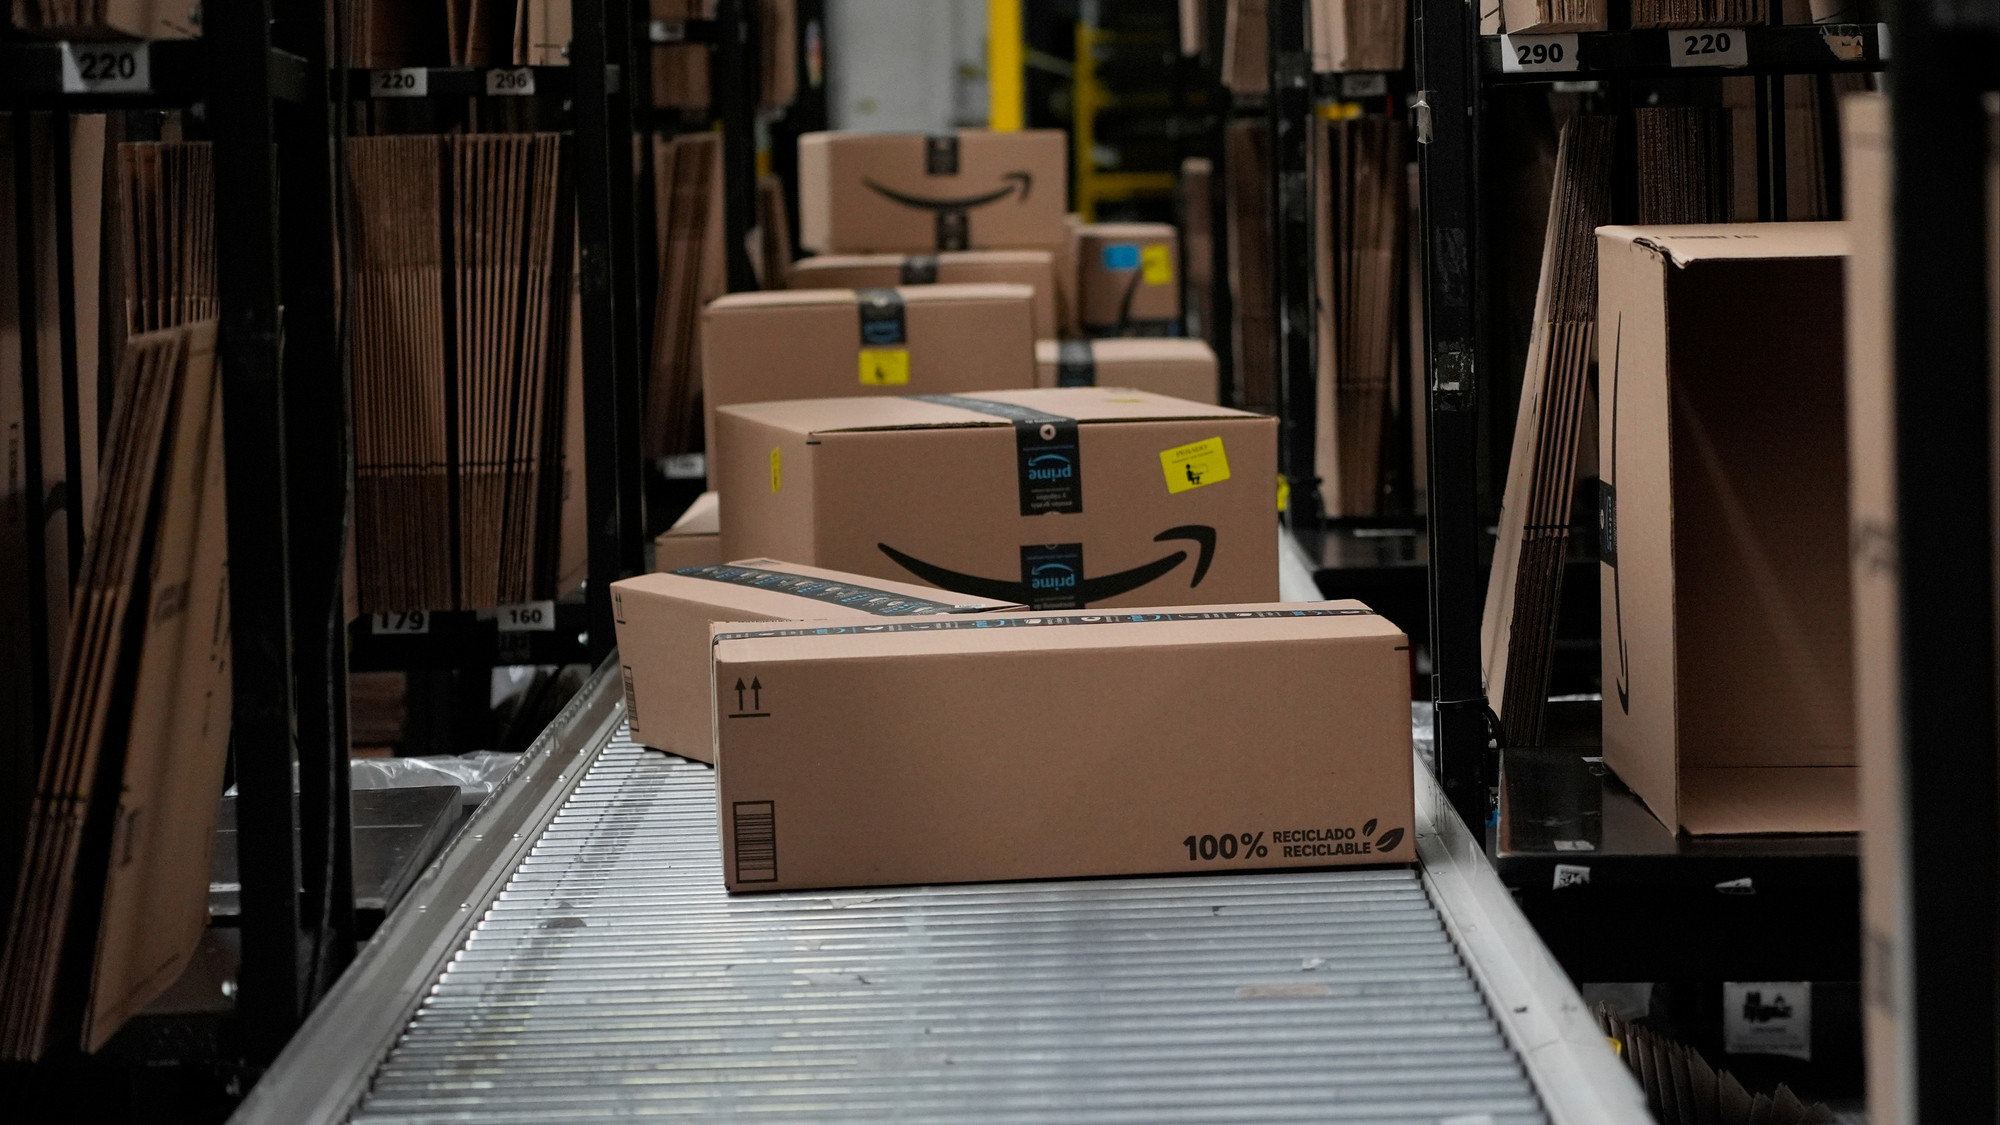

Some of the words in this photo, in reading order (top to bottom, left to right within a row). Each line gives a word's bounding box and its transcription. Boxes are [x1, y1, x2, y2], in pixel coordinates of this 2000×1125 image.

[1685, 33, 1731, 55] 220
[1517, 43, 1564, 65] 290
[80, 53, 135, 79] 220
[381, 74, 415, 89] 220
[496, 73, 527, 89] 296
[1028, 464, 1072, 482] prime
[1031, 573, 1076, 591] prime
[509, 608, 542, 624] 160
[1182, 831, 1268, 861] 100%
[1272, 828, 1356, 843] RECICLADO
[1283, 841, 1371, 858] RECICLABLE
